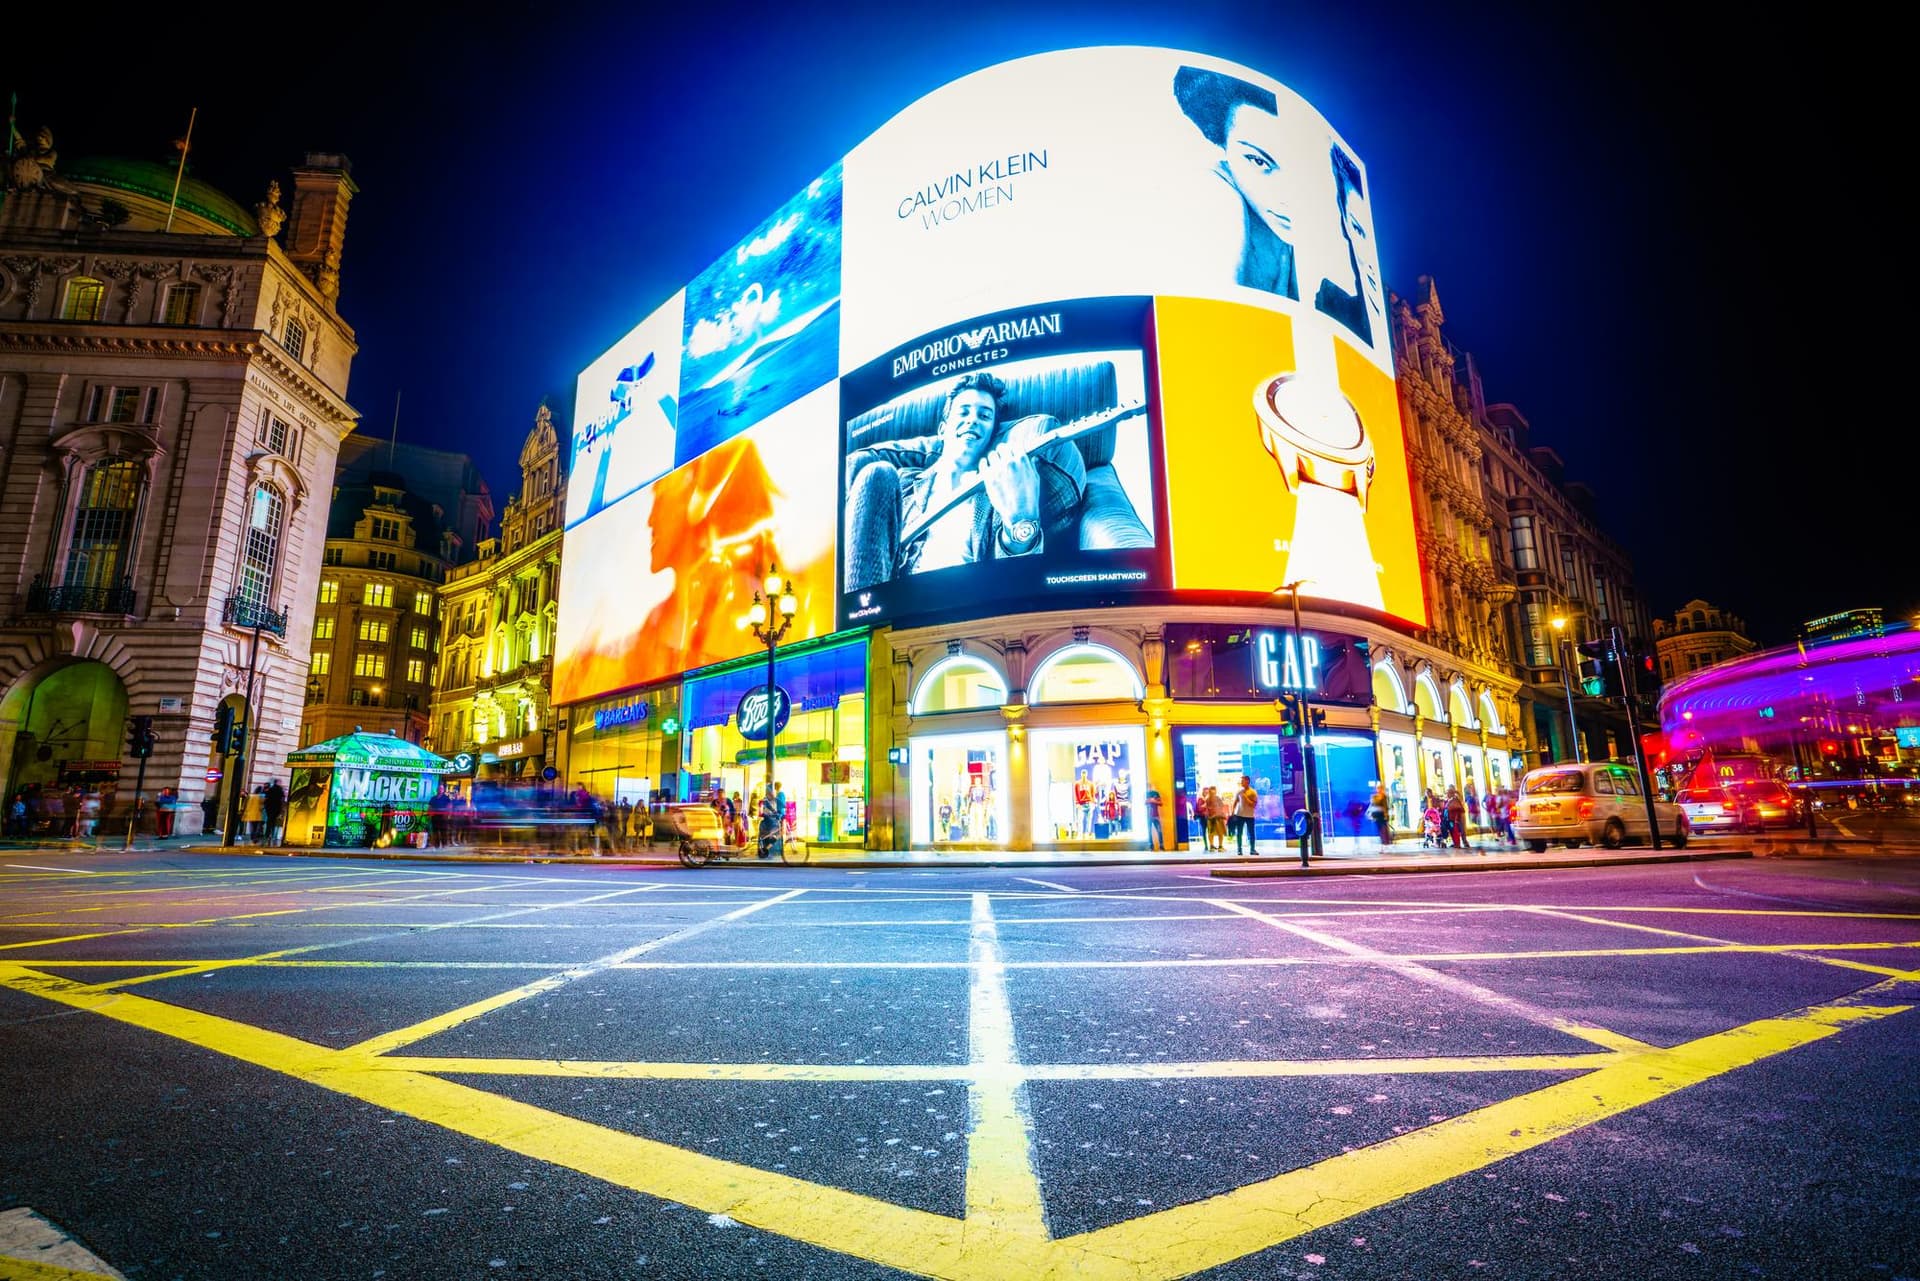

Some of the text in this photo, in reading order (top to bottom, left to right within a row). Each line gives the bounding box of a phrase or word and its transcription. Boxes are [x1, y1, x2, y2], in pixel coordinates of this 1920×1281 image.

[898, 149, 1048, 219] CALVIN KLEIN
[922, 183, 1013, 230] WOMEN
[892, 313, 1061, 378] EMPORIO ARMANI
[251, 374, 317, 430] ALLIANCE LIFE OFFICE
[1046, 573, 1146, 584] TOUCHSCREEN SMARTWATCH
[1259, 633, 1319, 689] GAP
[604, 702, 649, 729] BARCLAYS
[1074, 740, 1121, 768] GAP
[1671, 764, 1684, 772] 38
[394, 814, 410, 825] 100
